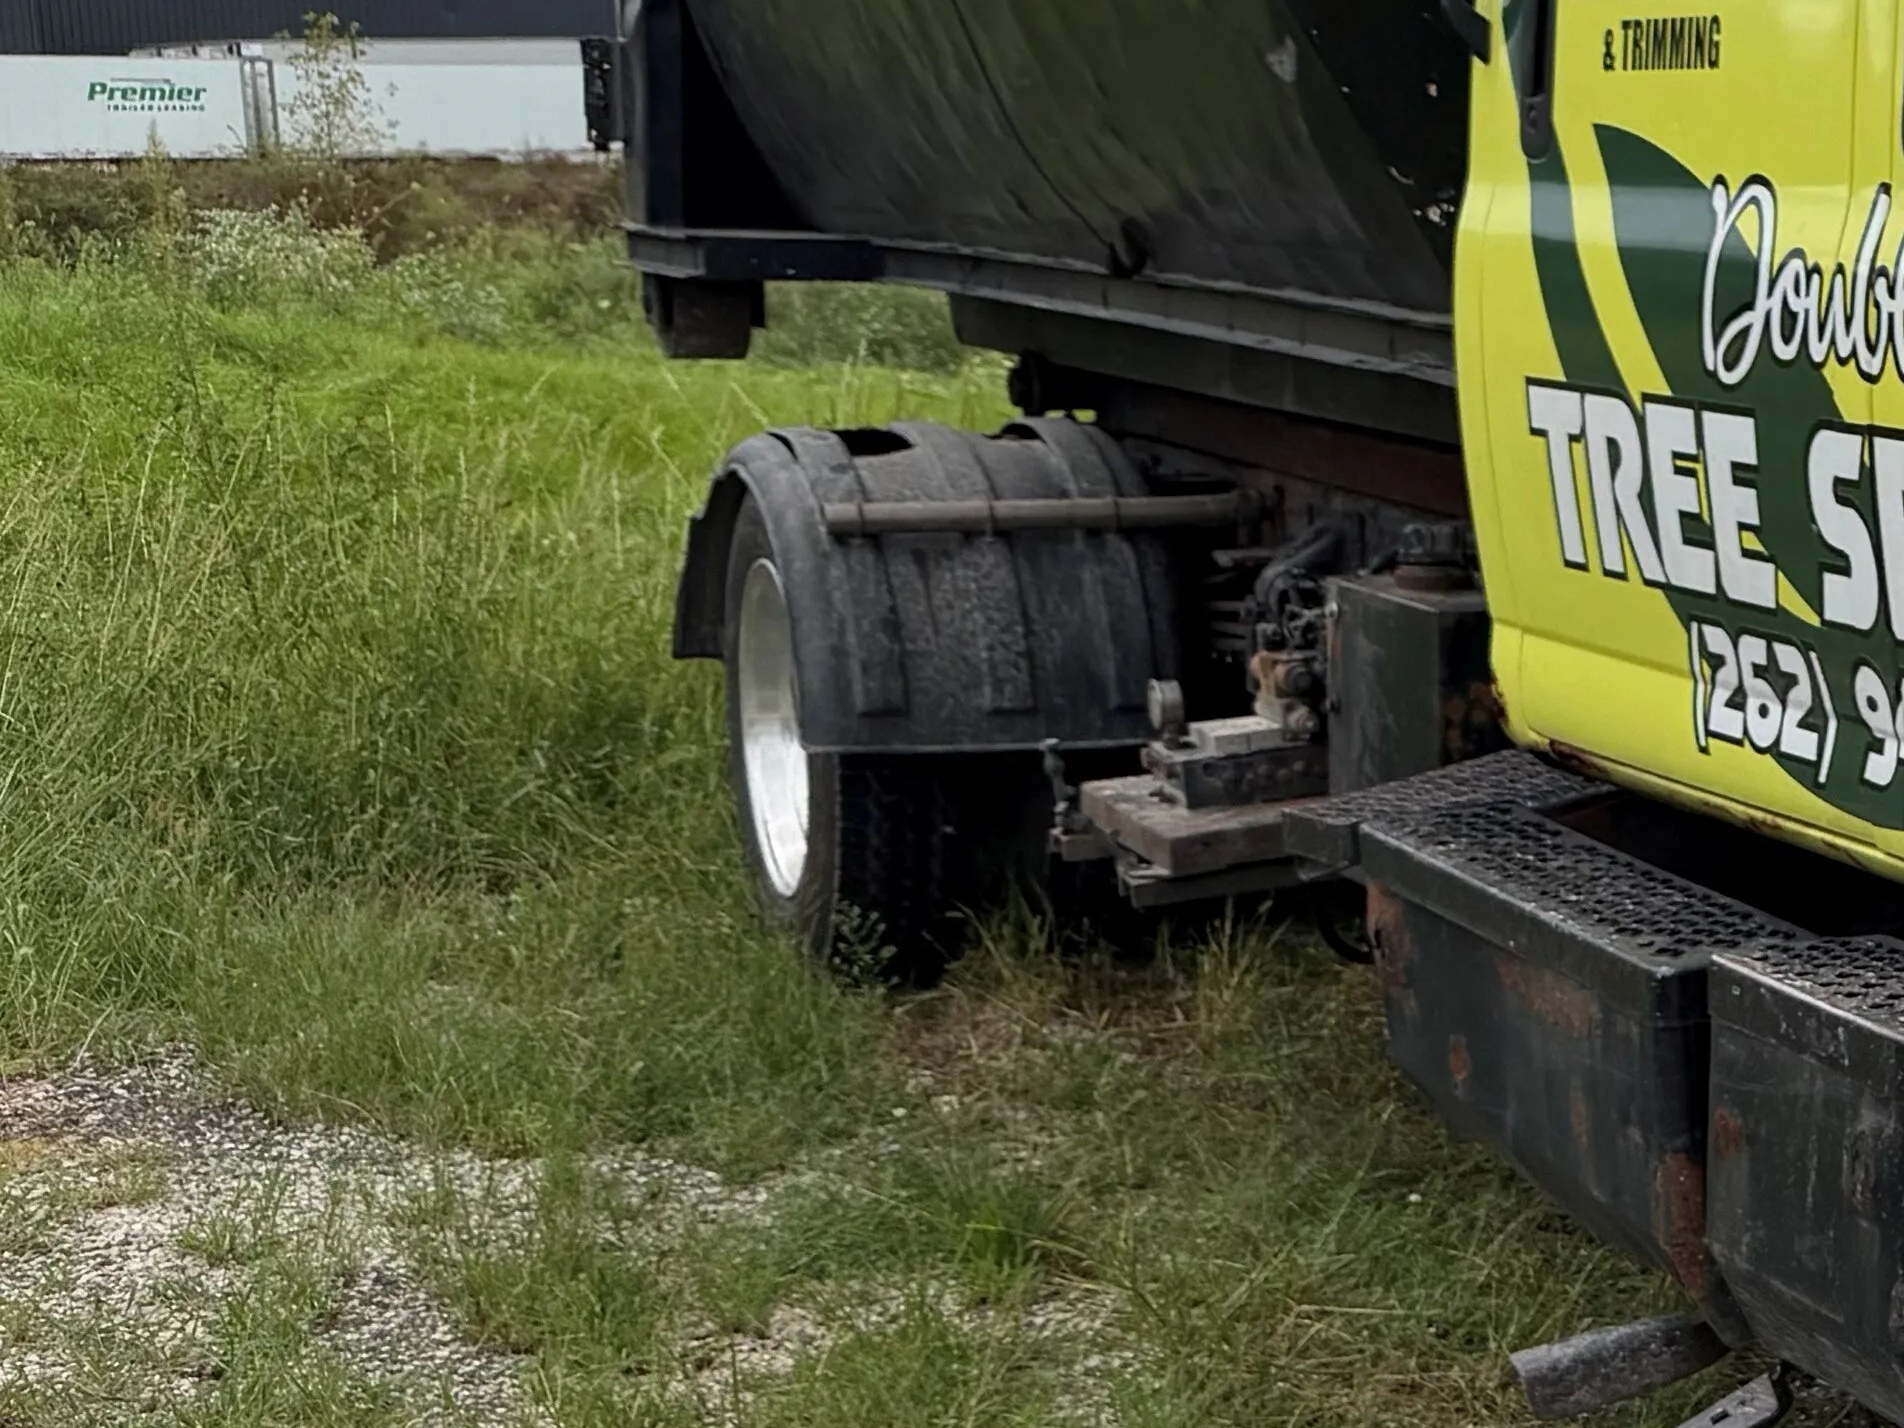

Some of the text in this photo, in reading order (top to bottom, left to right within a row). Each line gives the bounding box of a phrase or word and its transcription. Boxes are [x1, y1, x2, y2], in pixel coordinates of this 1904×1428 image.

[88, 81, 207, 102] Premier
[1621, 15, 1721, 71] TRIMMING
[1525, 376, 1778, 612] TREE
[1688, 615, 1838, 787] (262)
